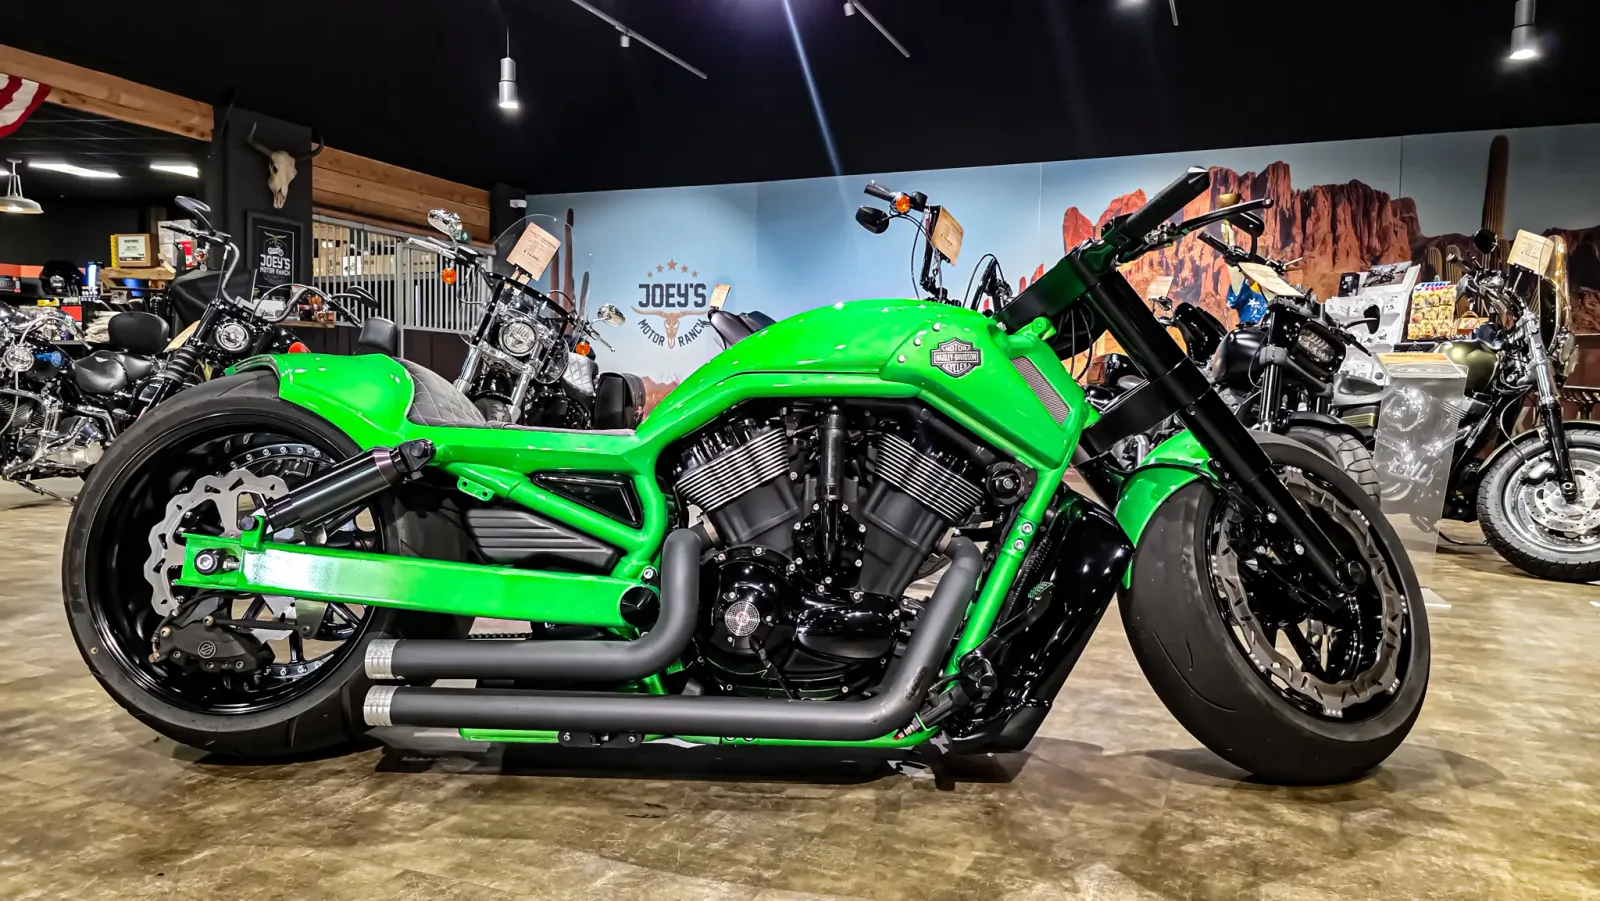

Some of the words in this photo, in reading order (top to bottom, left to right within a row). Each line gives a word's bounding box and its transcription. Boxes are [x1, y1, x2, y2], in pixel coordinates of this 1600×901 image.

[260, 254, 291, 270] JOEY'S
[260, 266, 275, 274] MOTOR
[276, 268, 291, 276] RANCH
[638, 283, 707, 308] JOEY'S
[638, 319, 665, 347] MOTOR
[677, 318, 705, 347] RANCH
[935, 353, 977, 361] HARLEY-DAVIDSON
